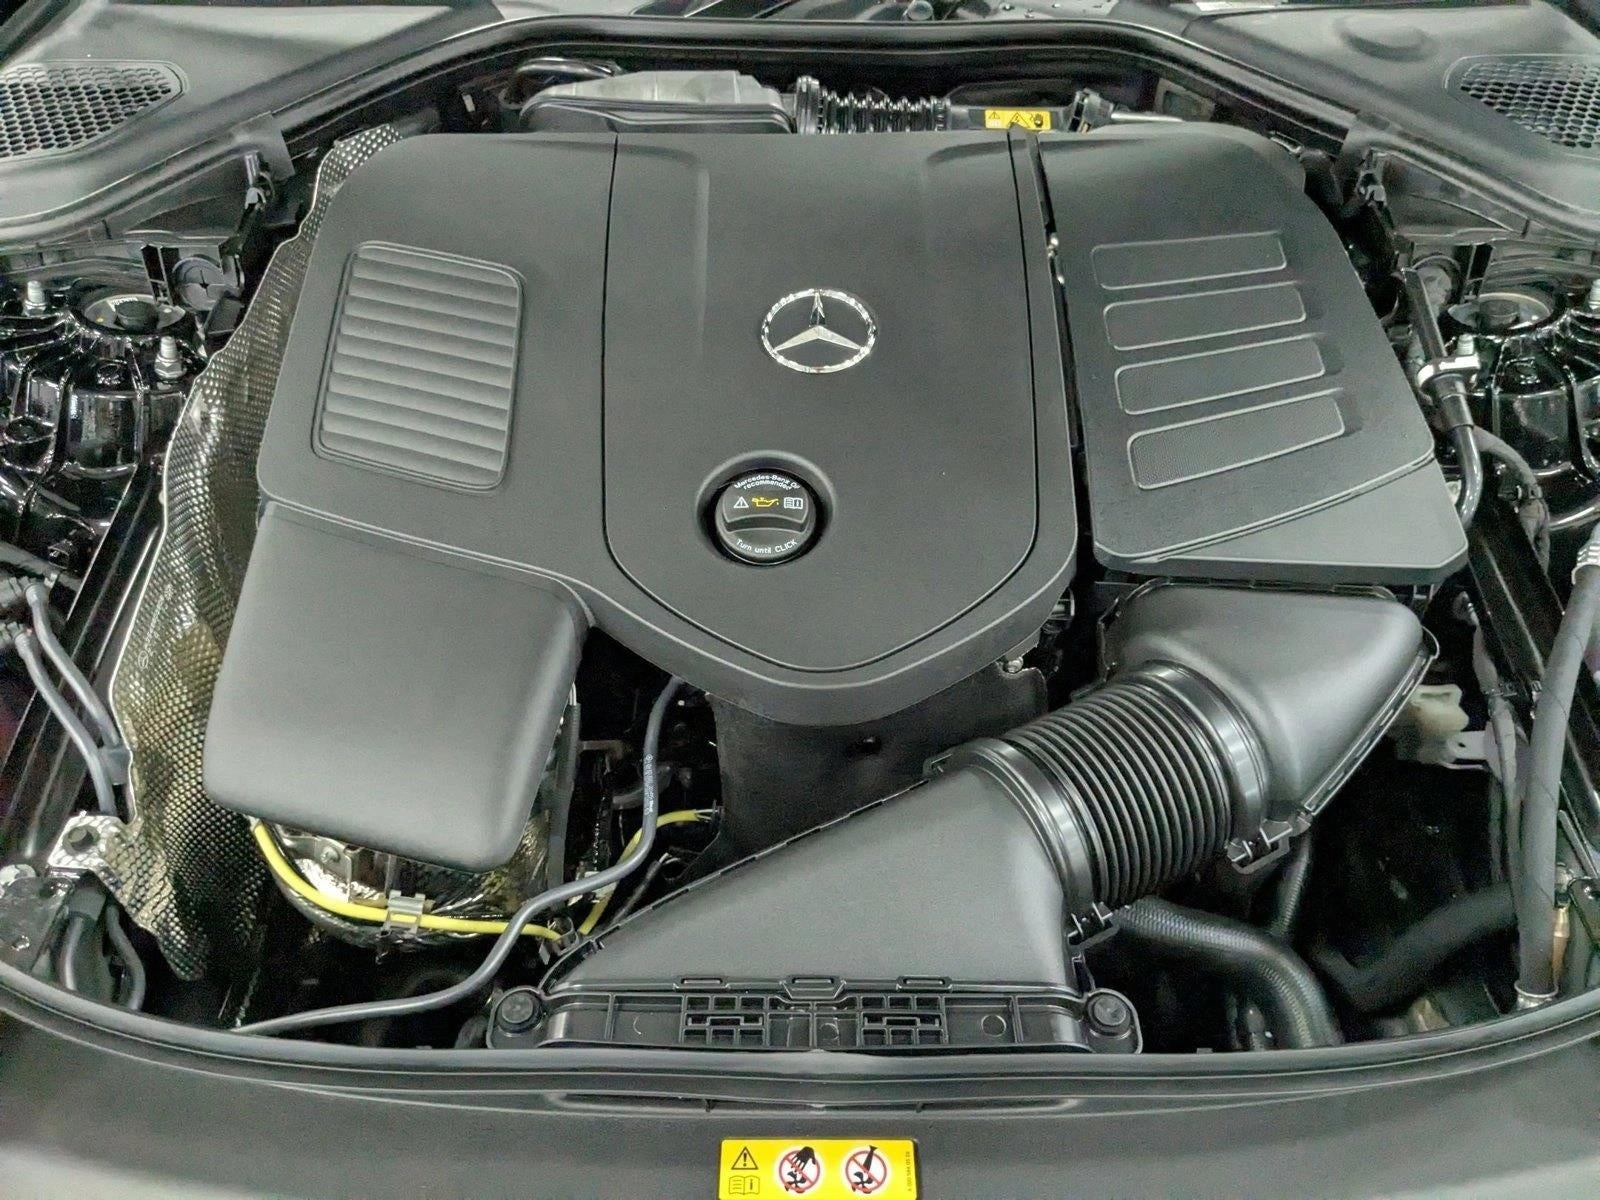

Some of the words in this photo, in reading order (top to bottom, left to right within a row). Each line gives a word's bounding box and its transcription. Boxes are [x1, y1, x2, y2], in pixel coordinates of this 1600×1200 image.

[734, 474, 790, 489] Mercedes-Benz
[736, 538, 752, 551] Turn
[754, 546, 772, 554] until
[775, 539, 798, 553] CLICK
